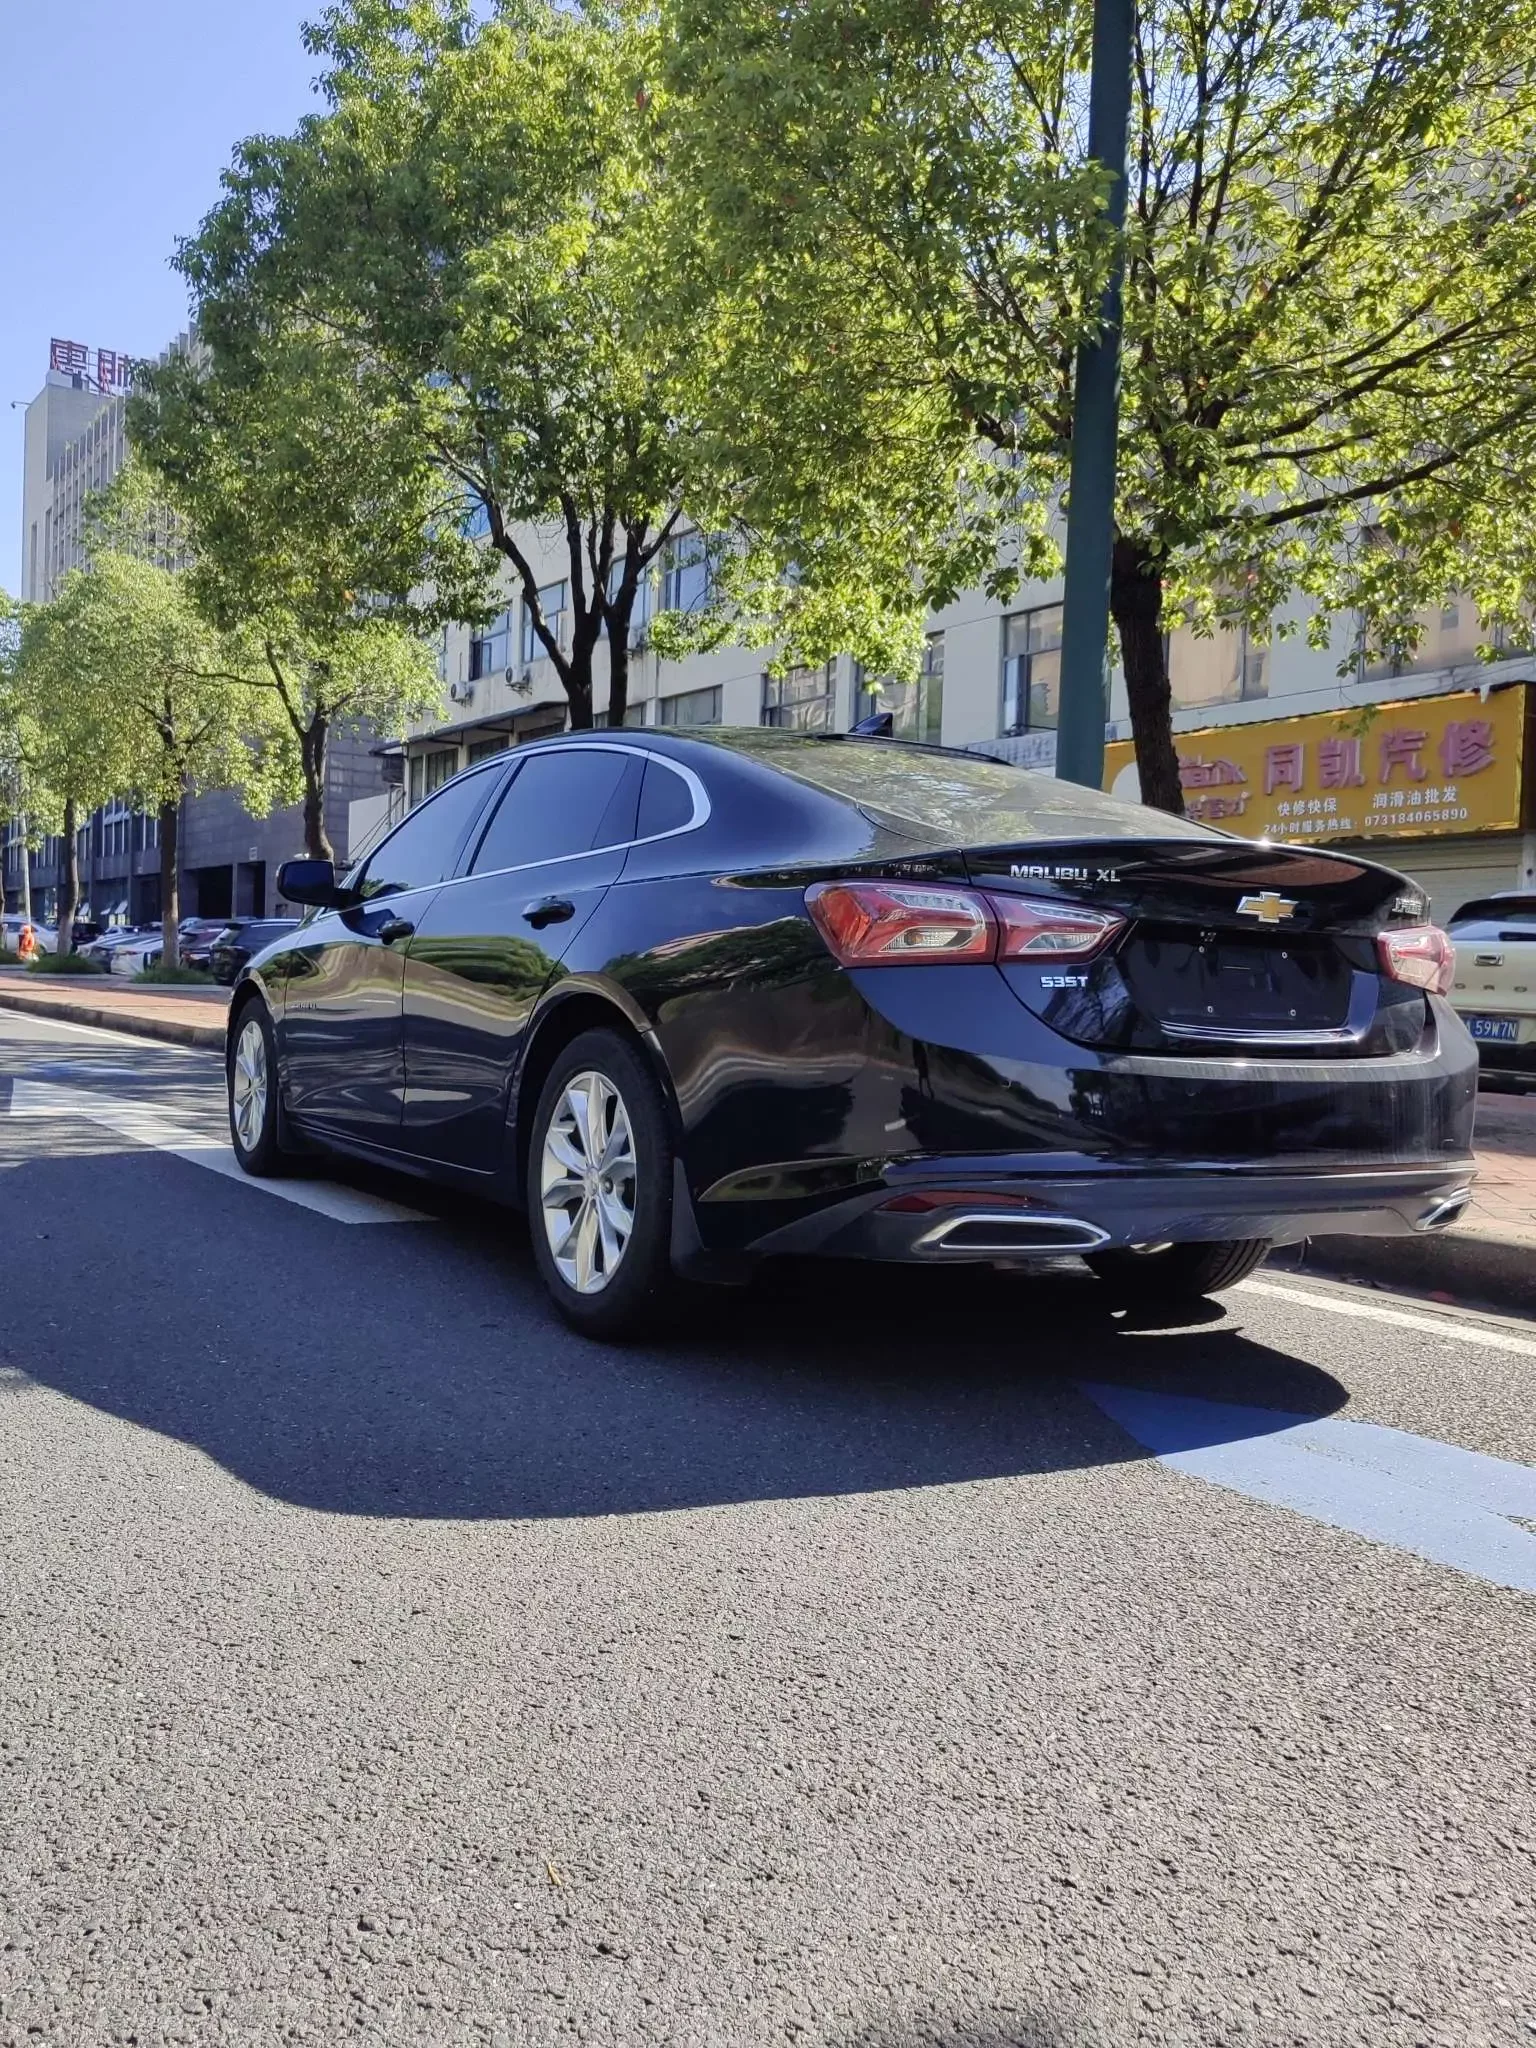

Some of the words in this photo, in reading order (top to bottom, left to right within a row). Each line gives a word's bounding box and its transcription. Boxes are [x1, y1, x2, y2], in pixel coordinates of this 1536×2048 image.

[1264, 718, 1496, 796] 同凯汽修
[1276, 797, 1338, 817] 快修快保
[1372, 786, 1458, 810] 润滑油批发
[1010, 864, 1088, 881] MALIBU
[1096, 868, 1121, 882] XL
[1040, 976, 1089, 988] 535T
